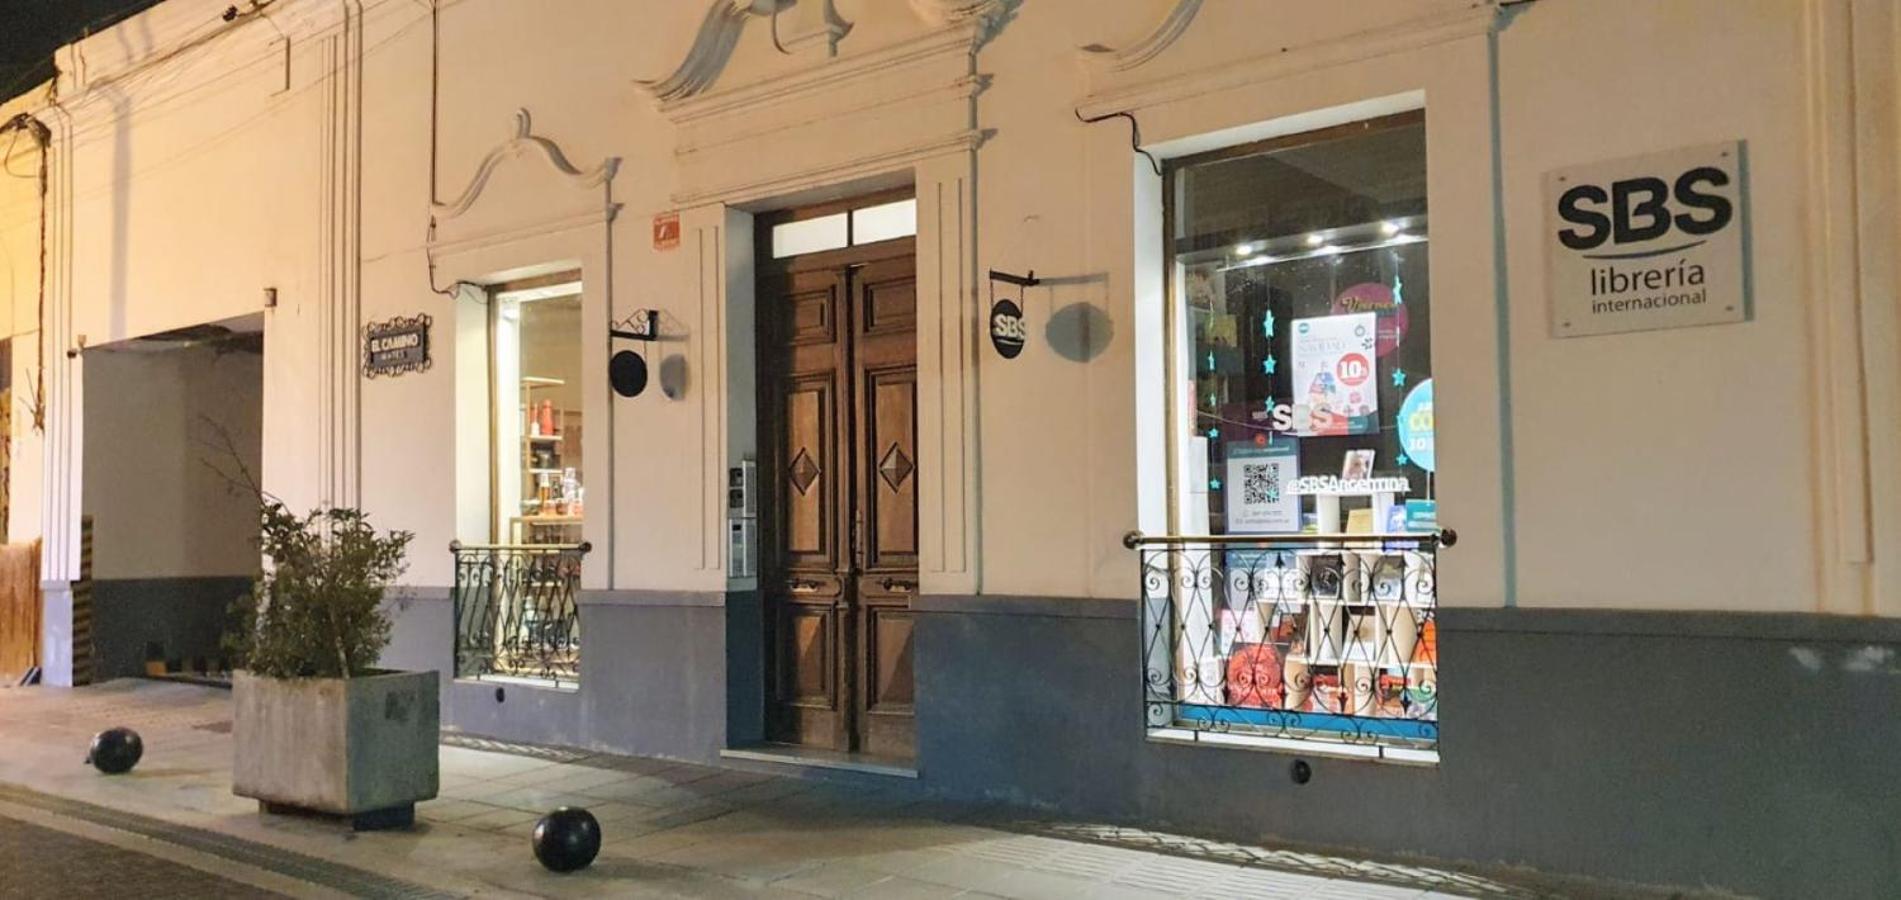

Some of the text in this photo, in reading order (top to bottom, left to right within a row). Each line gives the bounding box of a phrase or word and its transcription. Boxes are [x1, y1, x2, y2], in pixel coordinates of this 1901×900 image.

[1557, 166, 1733, 251] SBS
[1590, 258, 1706, 296] librería
[1591, 289, 1708, 314] internacional
[993, 314, 1027, 338] SBS
[381, 333, 418, 350] CAMINO
